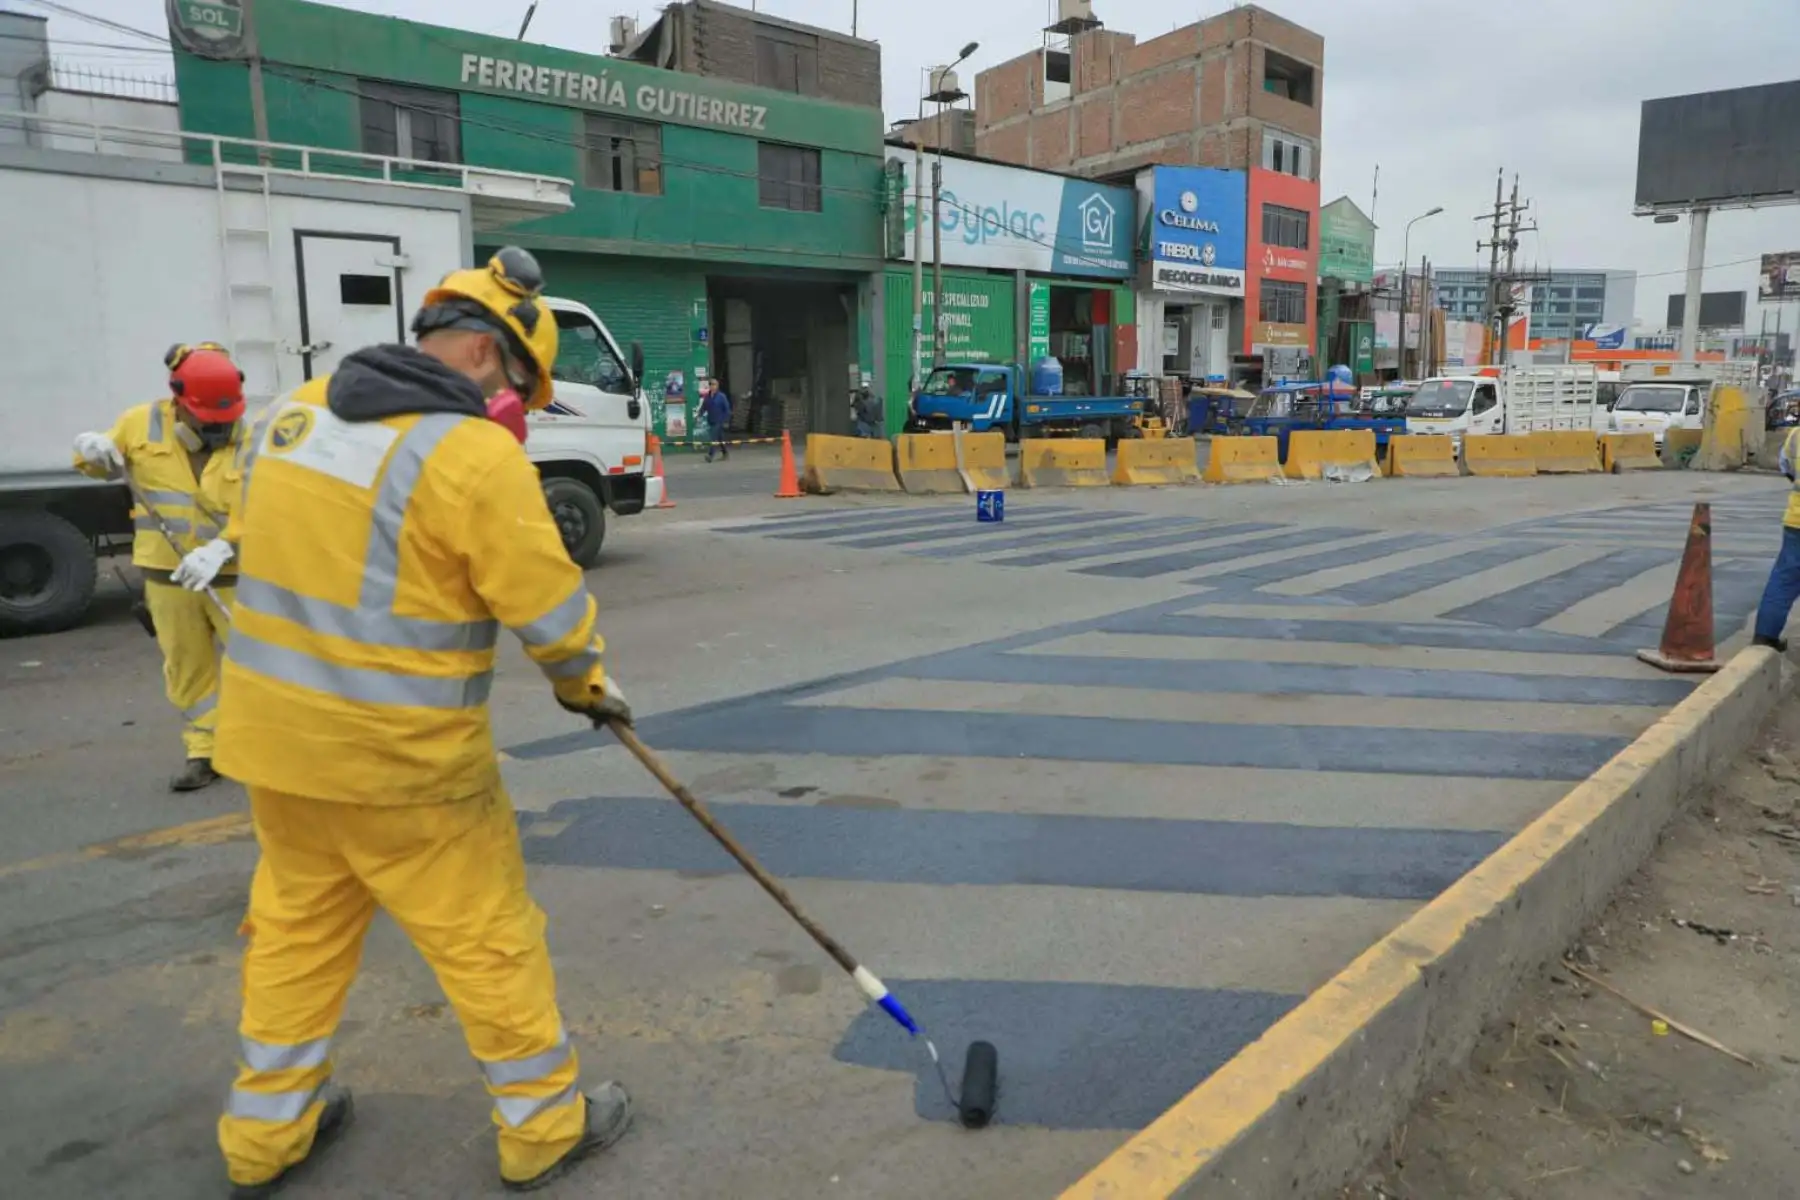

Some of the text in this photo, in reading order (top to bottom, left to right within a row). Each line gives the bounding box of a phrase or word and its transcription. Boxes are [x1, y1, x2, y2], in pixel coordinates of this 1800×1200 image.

[189, 5, 229, 26] SOL
[460, 53, 767, 131] FERRETERÍA GUTIERREZ
[939, 189, 1046, 245] Gyplac
[1159, 241, 1202, 261] TREBOL
